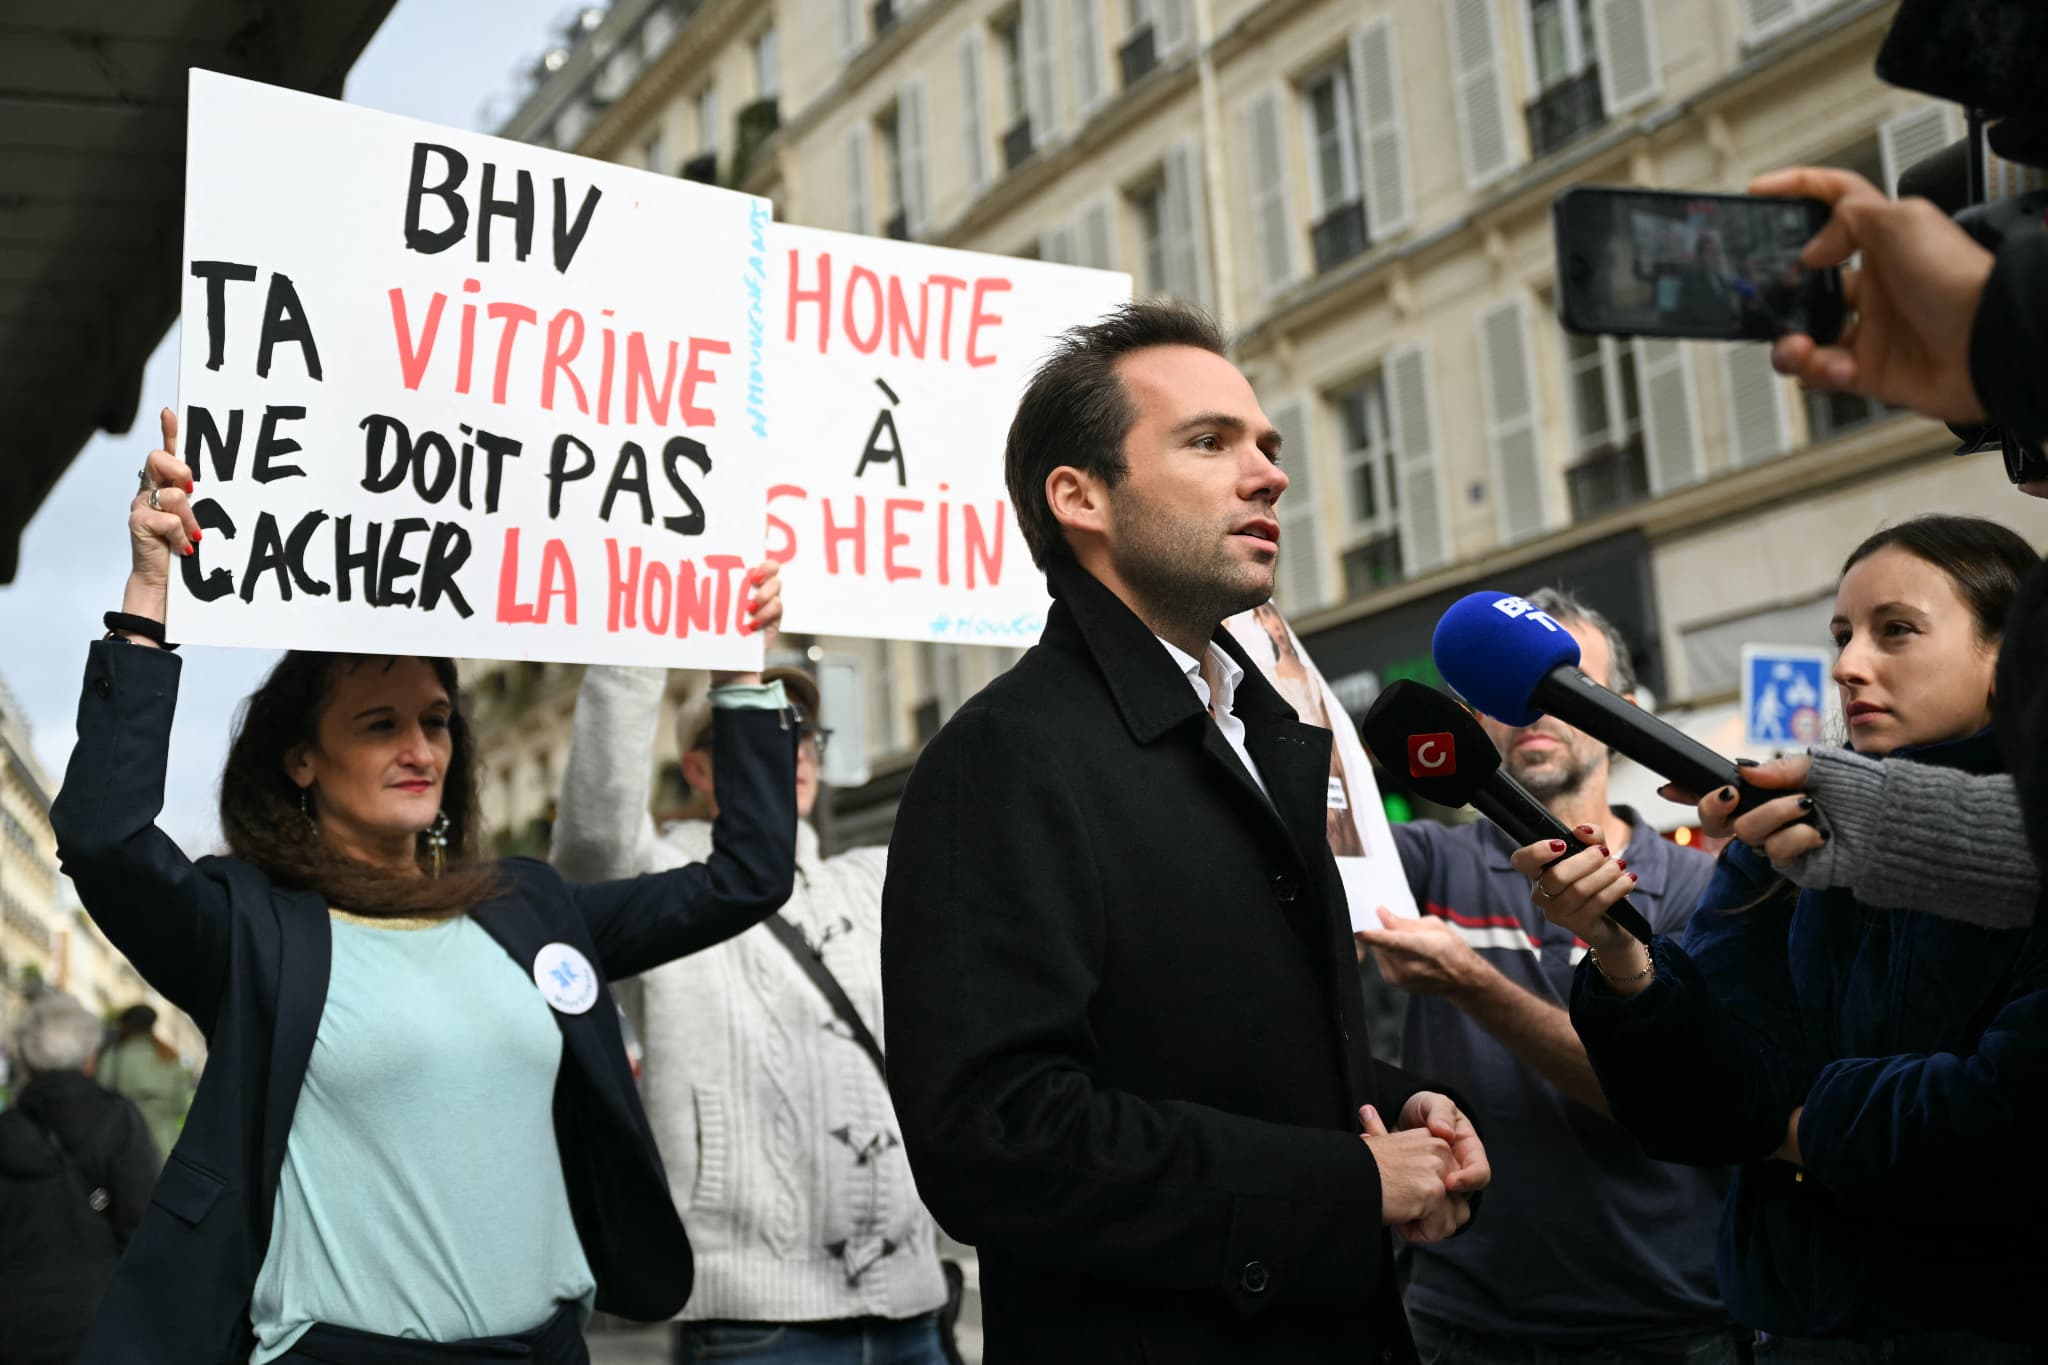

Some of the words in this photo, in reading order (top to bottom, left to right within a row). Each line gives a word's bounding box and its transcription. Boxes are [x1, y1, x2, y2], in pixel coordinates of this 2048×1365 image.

[404, 142, 602, 274] BHV
[190, 260, 322, 381] TA
[786, 249, 1012, 368] HONTE
[185, 405, 307, 484] NE
[545, 434, 712, 536] PAS
[856, 377, 906, 487] À
[181, 497, 475, 620] CACHER
[496, 527, 578, 626] LA
